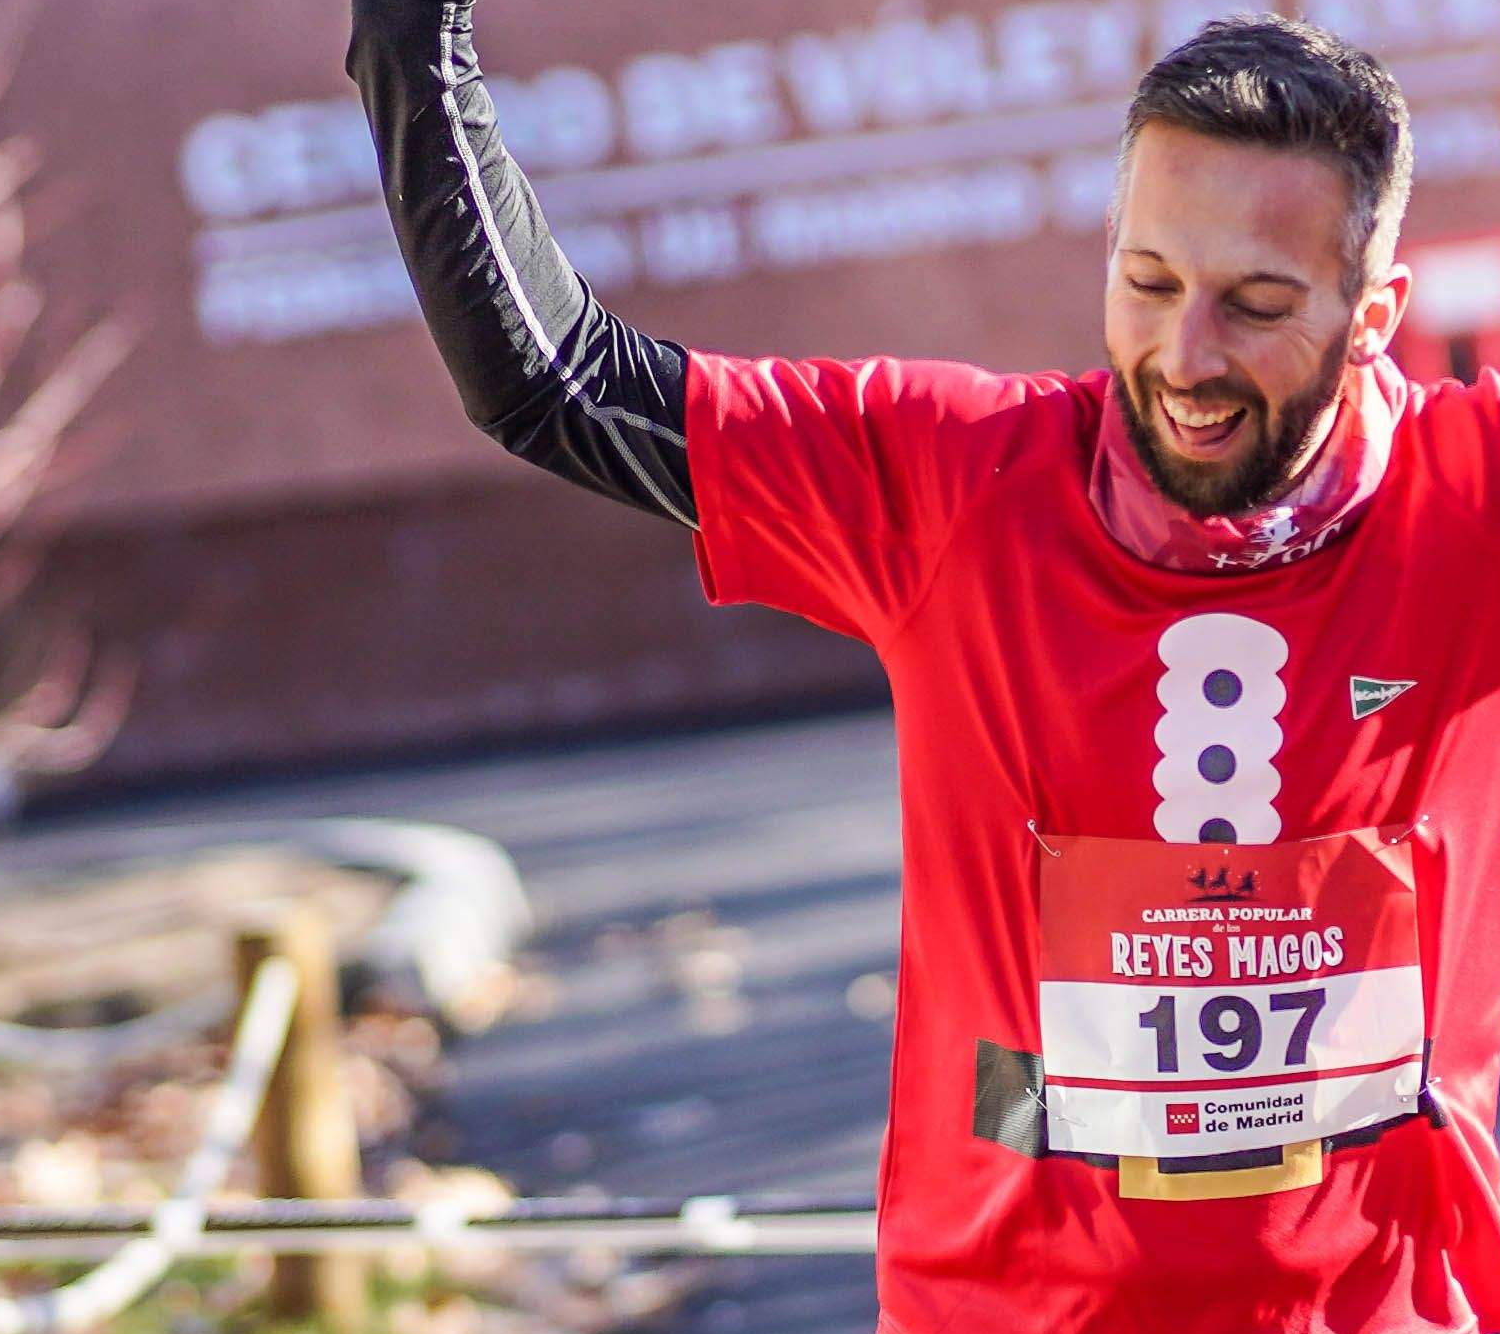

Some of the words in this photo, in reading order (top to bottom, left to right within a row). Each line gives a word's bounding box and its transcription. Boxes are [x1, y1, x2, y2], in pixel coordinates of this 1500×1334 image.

[1142, 908, 1224, 923] CARRERA
[1229, 907, 1313, 922] POPULAR
[1212, 923, 1225, 933] de
[1227, 923, 1241, 933] los
[1110, 932, 1213, 978] REYES
[1227, 926, 1344, 979] MAGOS
[1139, 987, 1326, 1073] 197
[1204, 1094, 1304, 1115] Comunidad
[1205, 1119, 1229, 1133] de
[1236, 1110, 1304, 1131] Madrid
